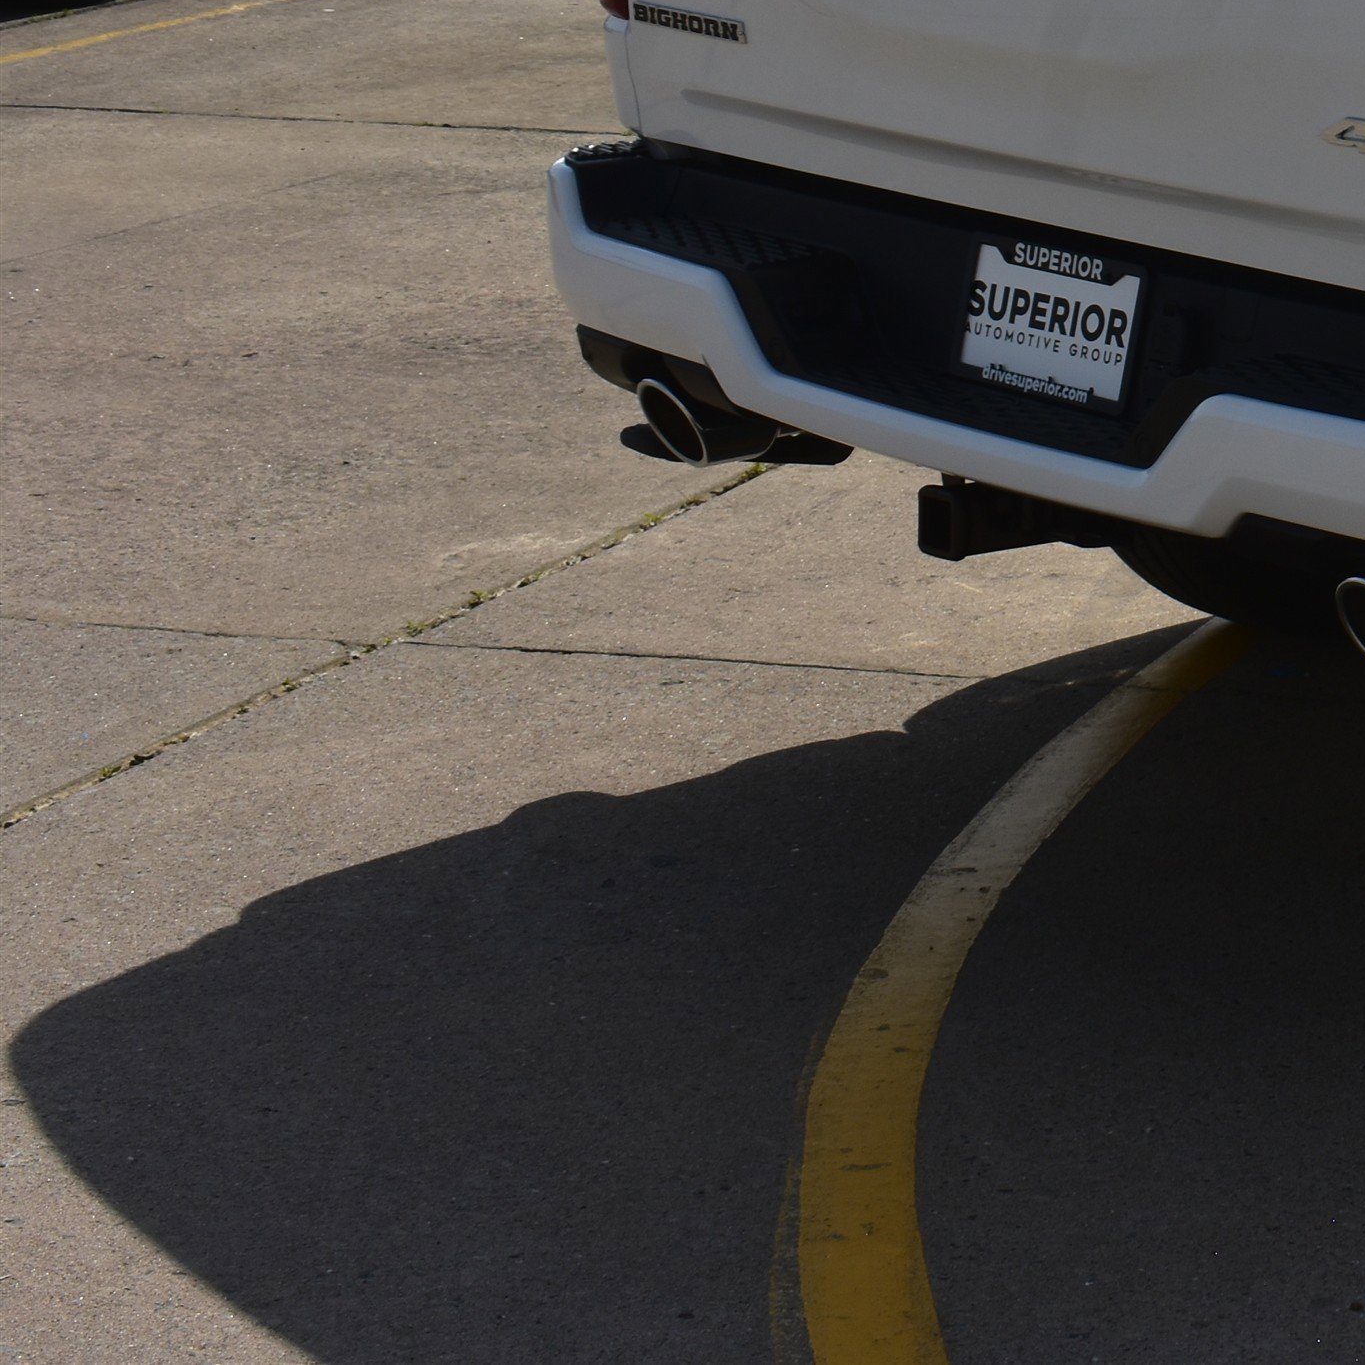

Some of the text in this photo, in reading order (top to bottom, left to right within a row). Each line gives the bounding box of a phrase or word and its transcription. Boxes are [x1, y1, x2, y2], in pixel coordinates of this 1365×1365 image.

[633, 2, 740, 42] BIGHORN
[1014, 242, 1103, 280] SUPERIOR
[968, 280, 1129, 348] SUPERIOR
[964, 320, 1123, 366] AUTOMOTIVE GROUP
[982, 365, 1089, 404] drivesuperior.com
